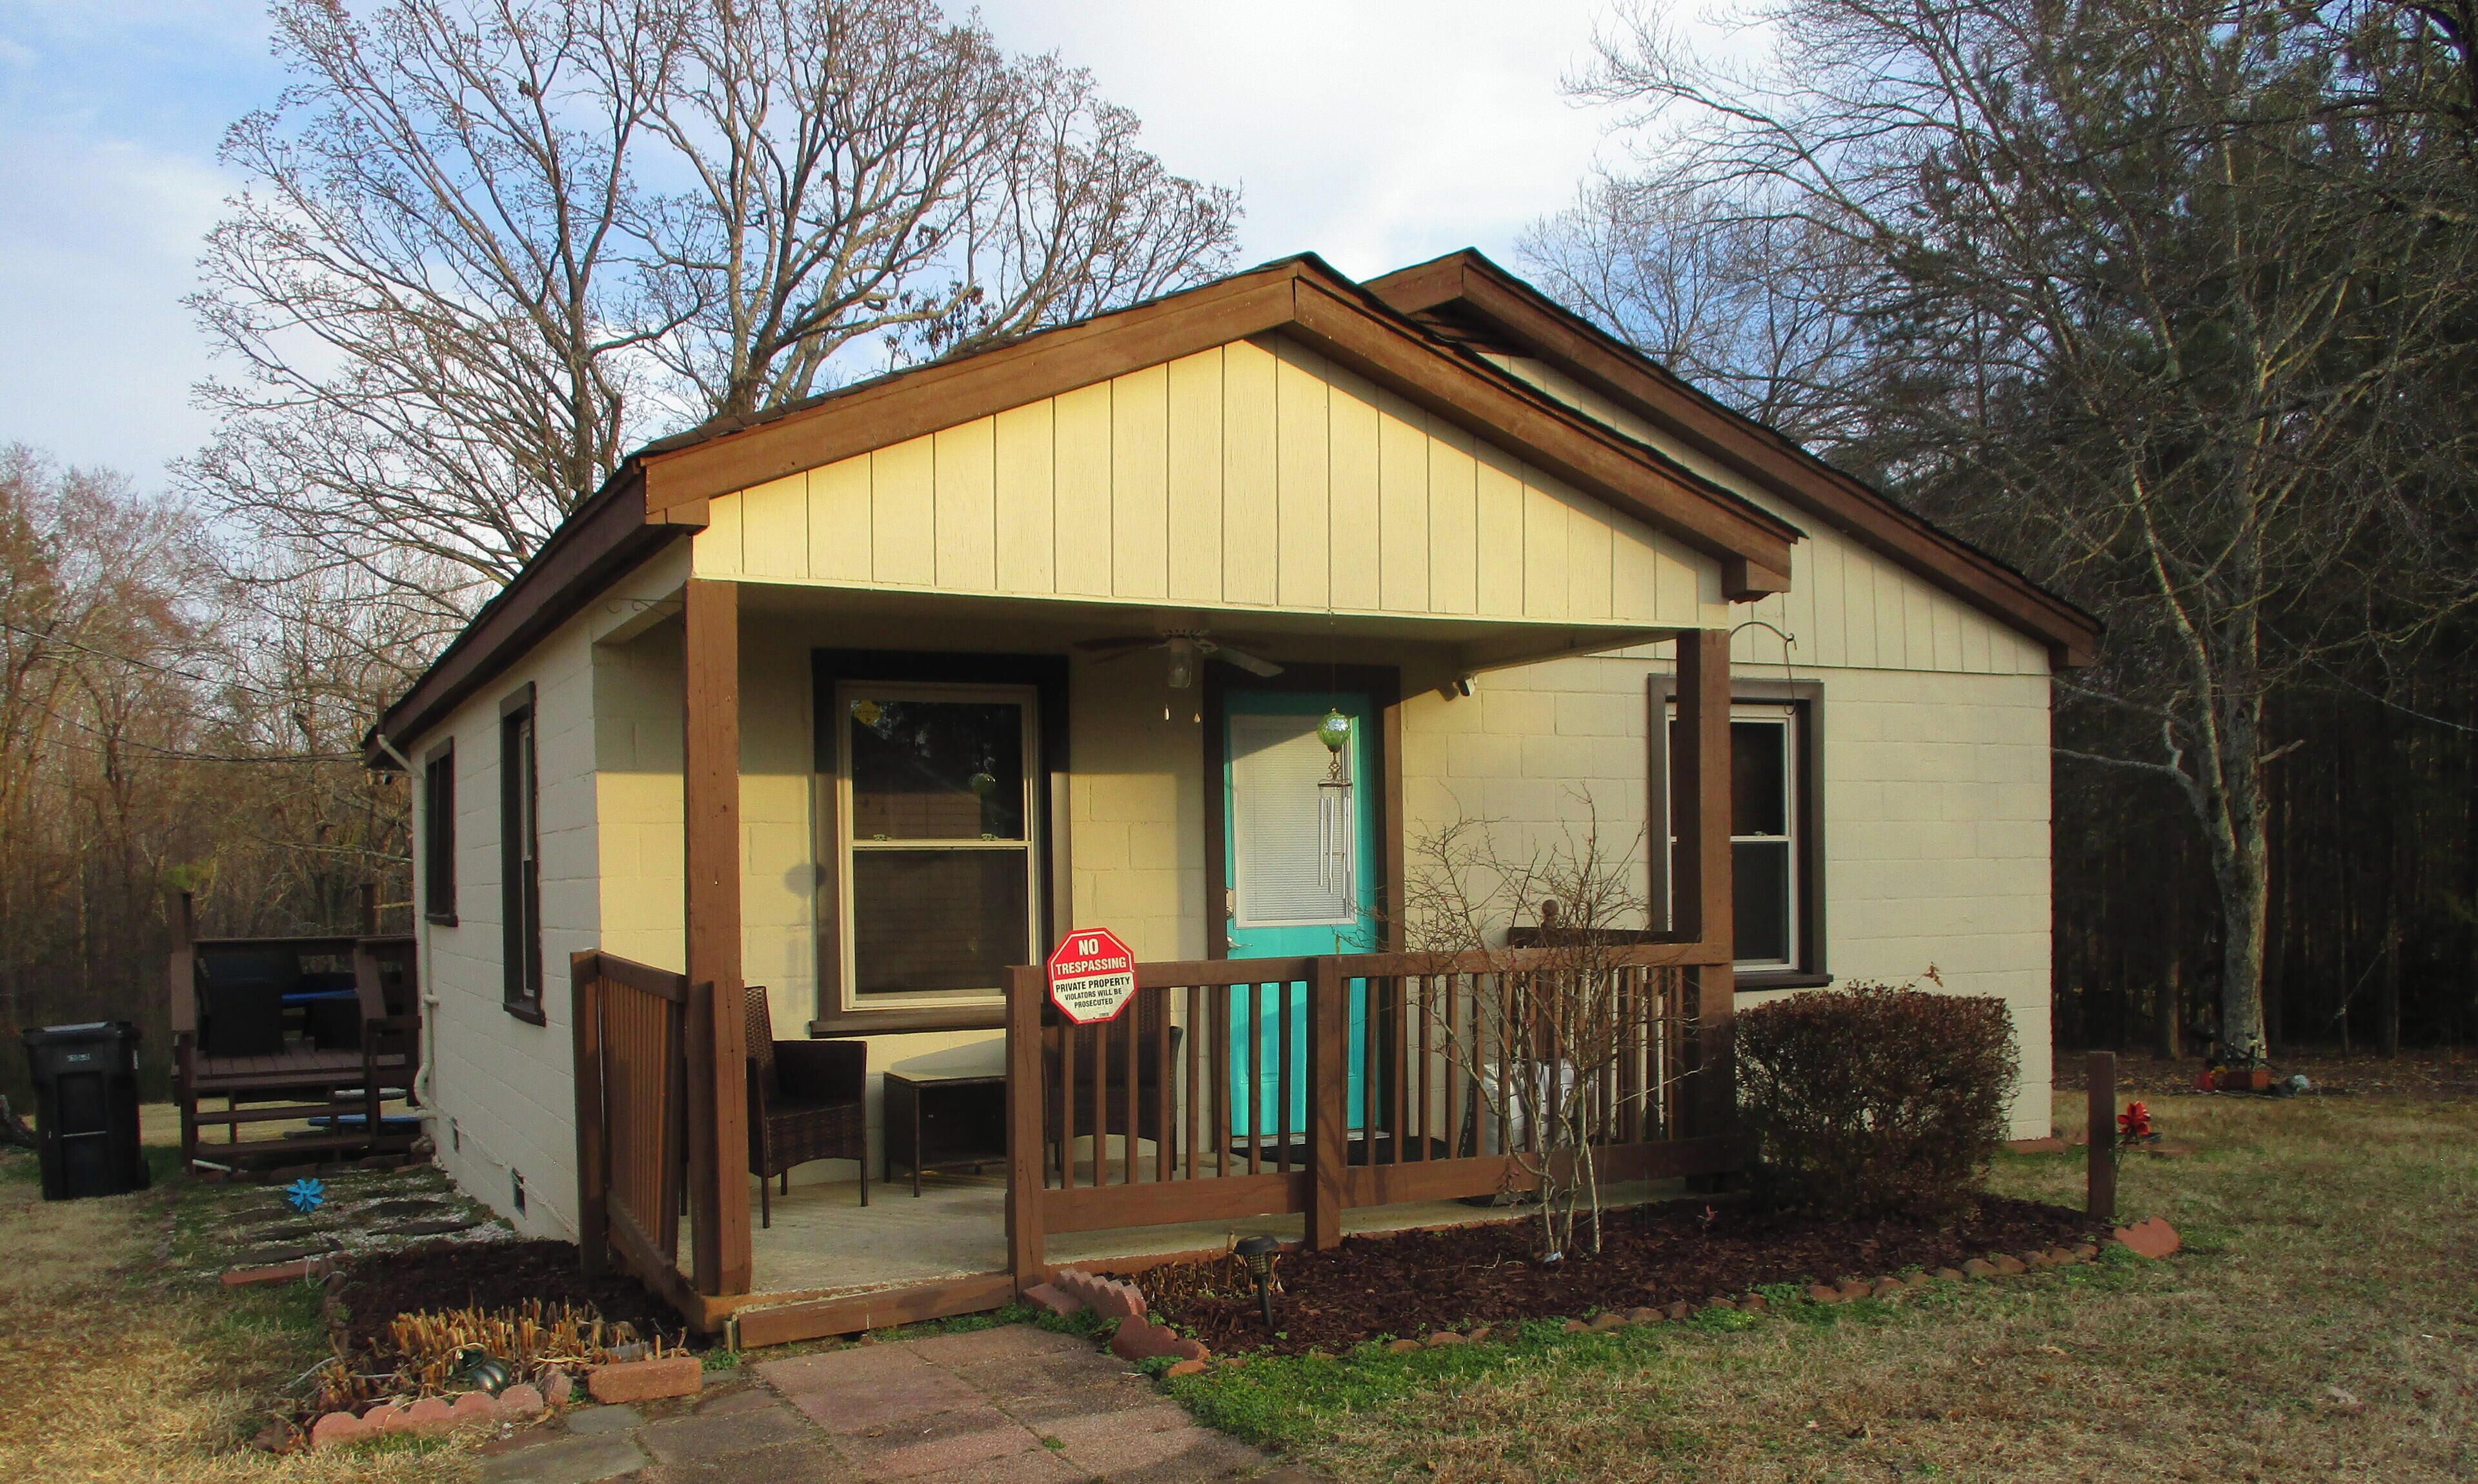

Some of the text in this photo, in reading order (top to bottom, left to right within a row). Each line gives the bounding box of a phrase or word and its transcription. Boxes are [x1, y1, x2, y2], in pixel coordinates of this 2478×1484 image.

[1078, 938, 1099, 956] NO
[1056, 957, 1126, 975] TRESPASSING
[1056, 976, 1130, 992] PRIVATE PROPERTY
[1065, 990, 1096, 1001] VIOLATORS
[1074, 998, 1113, 1008] PROSECUTED
